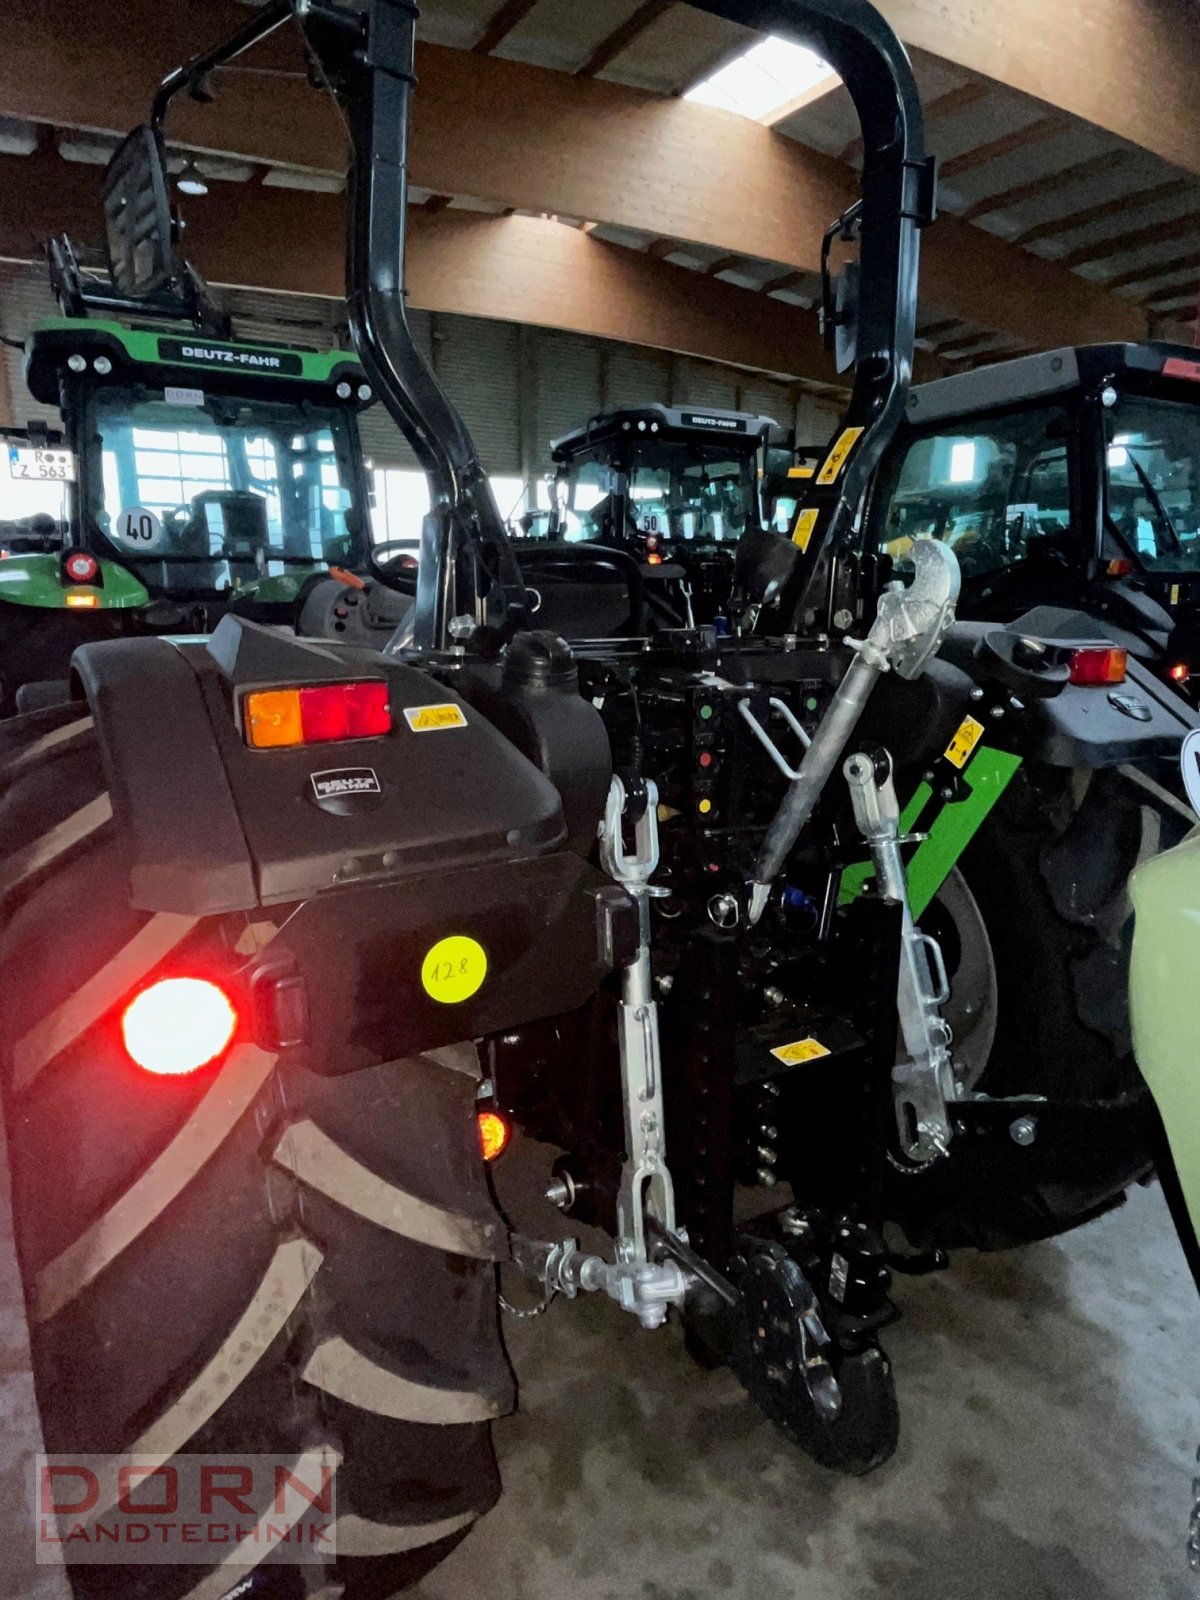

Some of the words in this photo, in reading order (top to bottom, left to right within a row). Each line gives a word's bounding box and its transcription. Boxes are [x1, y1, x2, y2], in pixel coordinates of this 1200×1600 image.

[181, 346, 280, 367] DEUTZ-FAHR
[34, 451, 44, 463] R
[20, 464, 30, 477] Z
[39, 465, 66, 478] 563
[126, 515, 152, 540] 40
[644, 515, 657, 531] 50
[430, 958, 468, 982] 128
